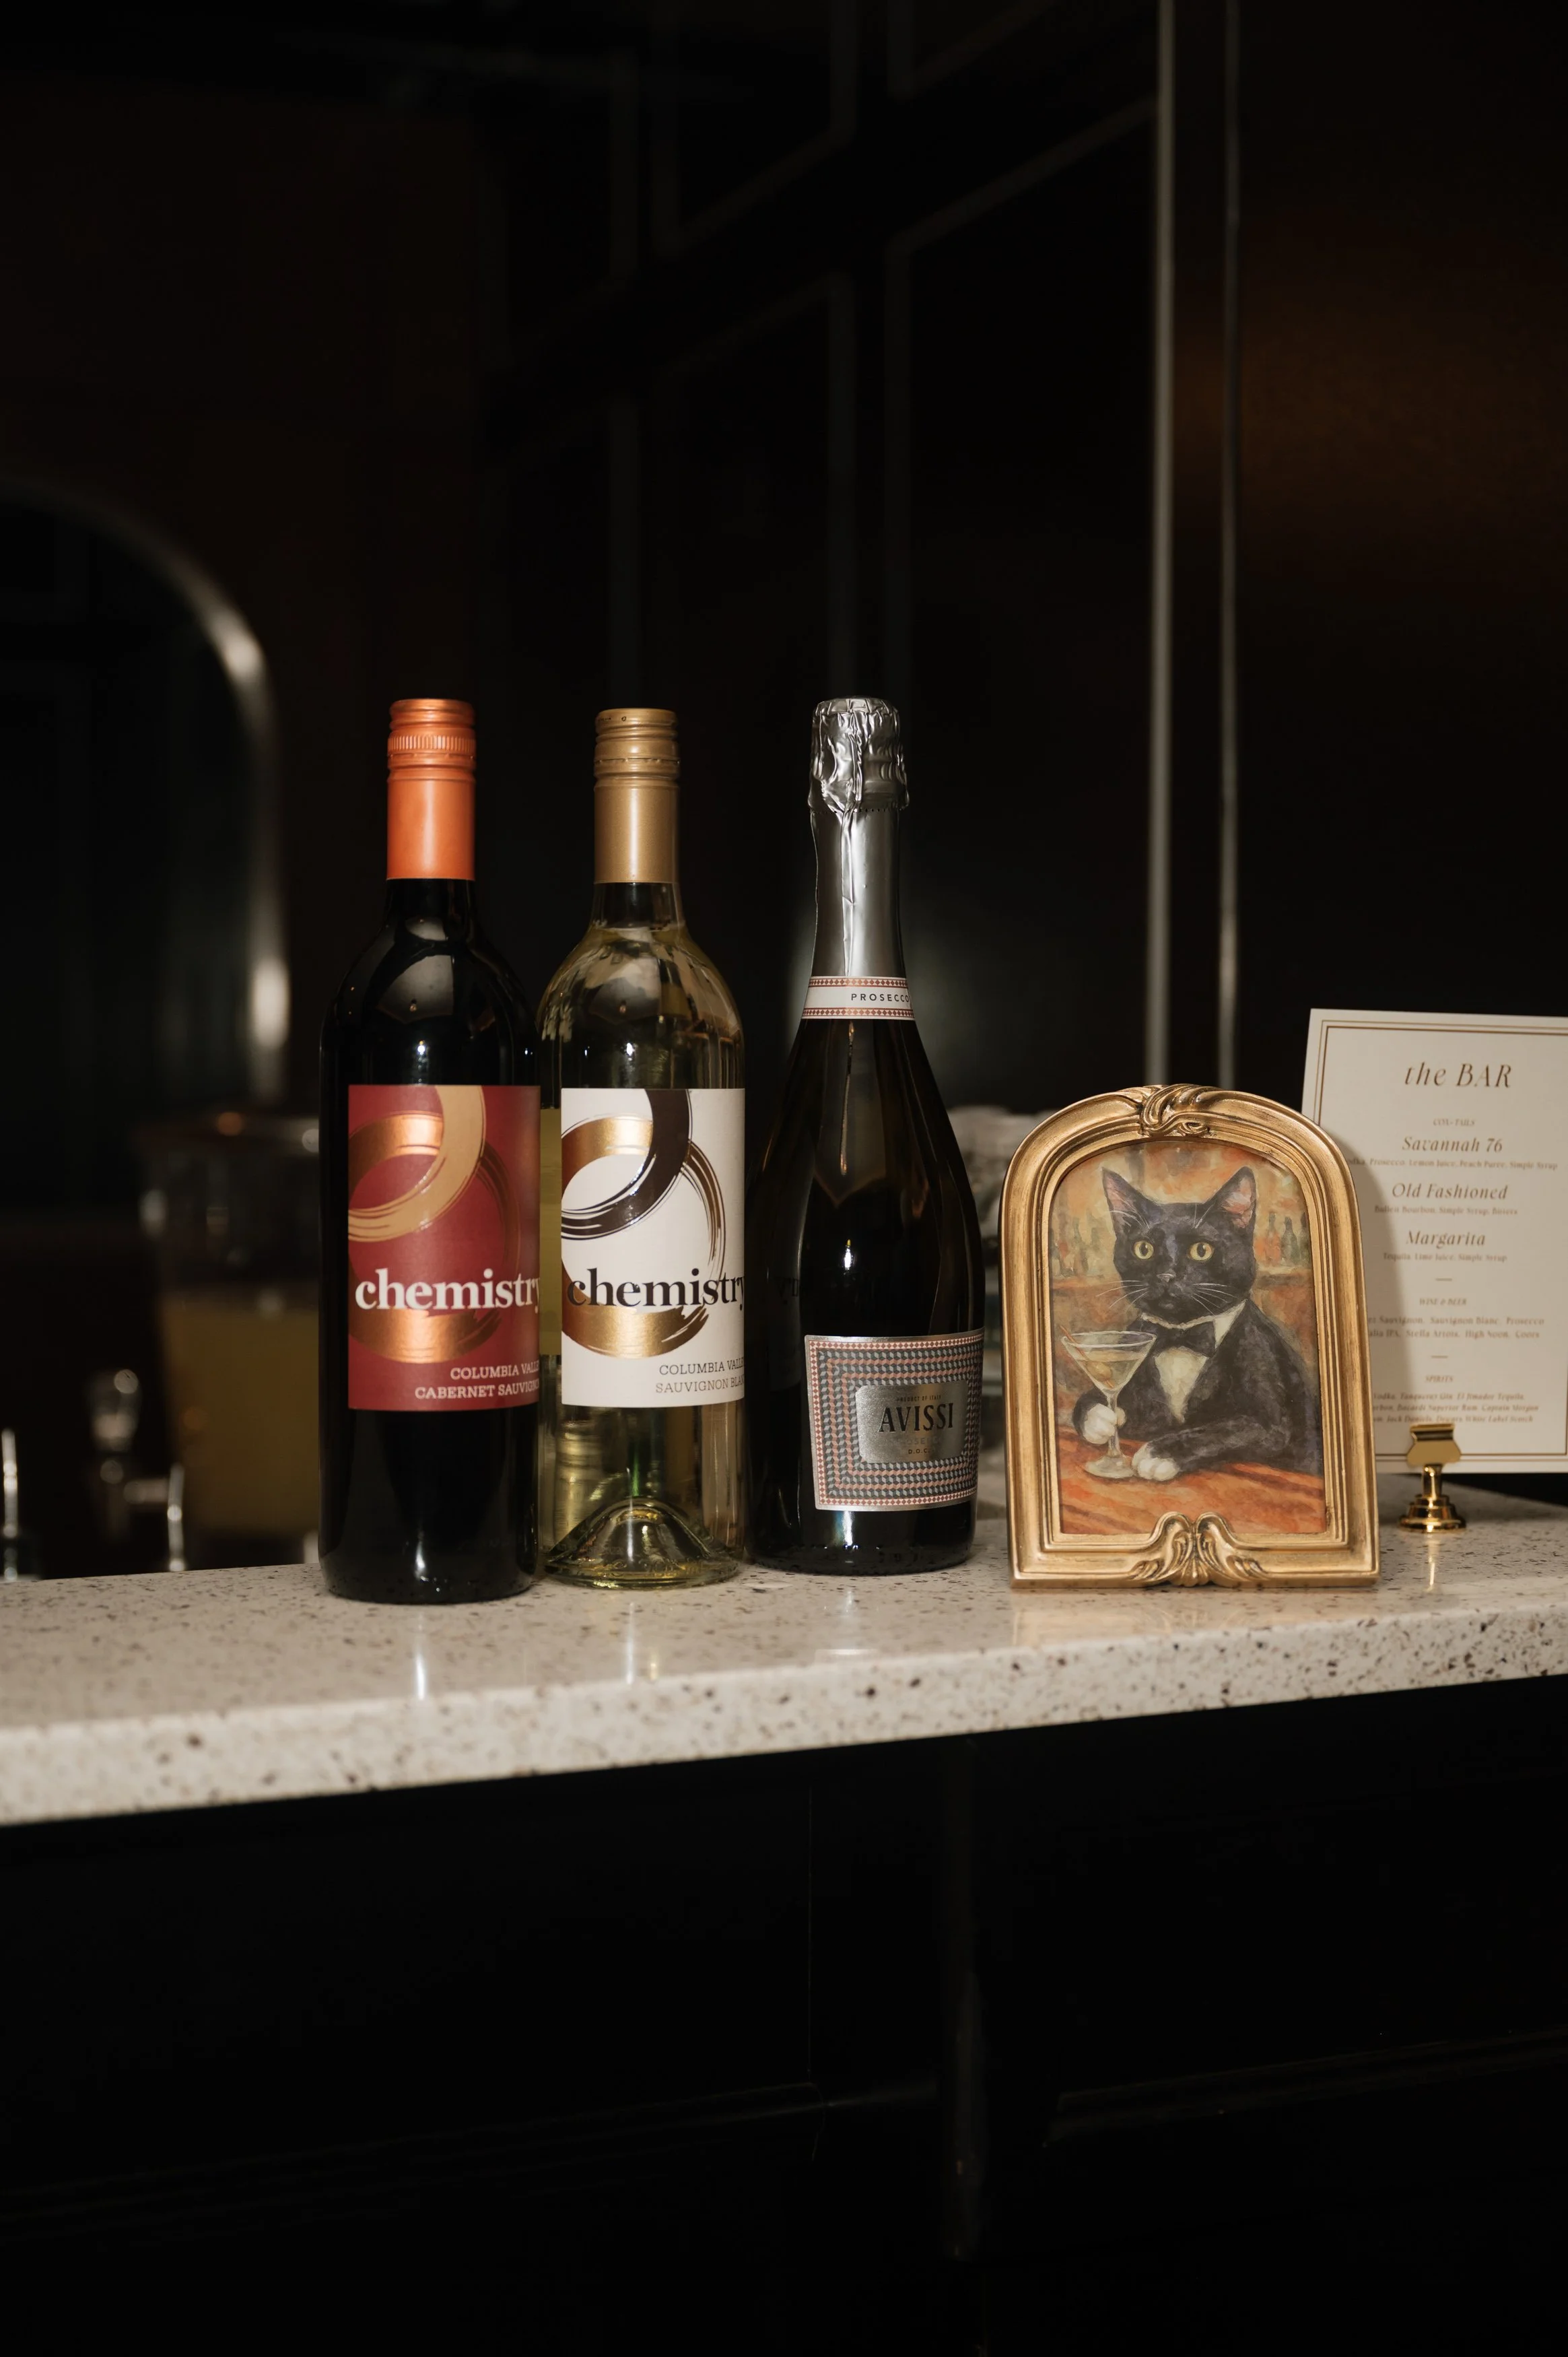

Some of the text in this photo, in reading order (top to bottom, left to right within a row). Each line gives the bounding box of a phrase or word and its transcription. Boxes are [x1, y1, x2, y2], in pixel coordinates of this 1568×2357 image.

[851, 993, 909, 1002] PROSECCO
[1404, 1062, 1512, 1088] the BAR
[1402, 1136, 1503, 1153] Savannah 76
[1409, 1158, 1434, 1166] Lemon
[1460, 1160, 1482, 1168] Peach
[1509, 1161, 1534, 1170] Simple
[1536, 1162, 1558, 1171] Syrup
[1392, 1183, 1508, 1199] Old Fashioned
[1439, 1206, 1464, 1216] Simple
[1492, 1207, 1518, 1215] Bitters
[1406, 1230, 1485, 1249] Margarita
[1414, 1253, 1433, 1261] Lime
[1458, 1253, 1482, 1263] Simple
[1485, 1255, 1507, 1263] Syrup
[355, 1268, 540, 1313] chemistry
[567, 1267, 745, 1311] chemistry
[1430, 1316, 1473, 1327] Sauvignon
[1506, 1317, 1544, 1325] Prosecco
[1406, 1329, 1430, 1337] Stella
[450, 1359, 539, 1381] COLUMBIA VALLE
[659, 1356, 744, 1376] COLUMBIA VALLE
[415, 1378, 539, 1399] CABERNET SAUVIGNO
[656, 1374, 744, 1394] SAUVIGNON BLAN
[878, 1403, 953, 1433] AVISSI
